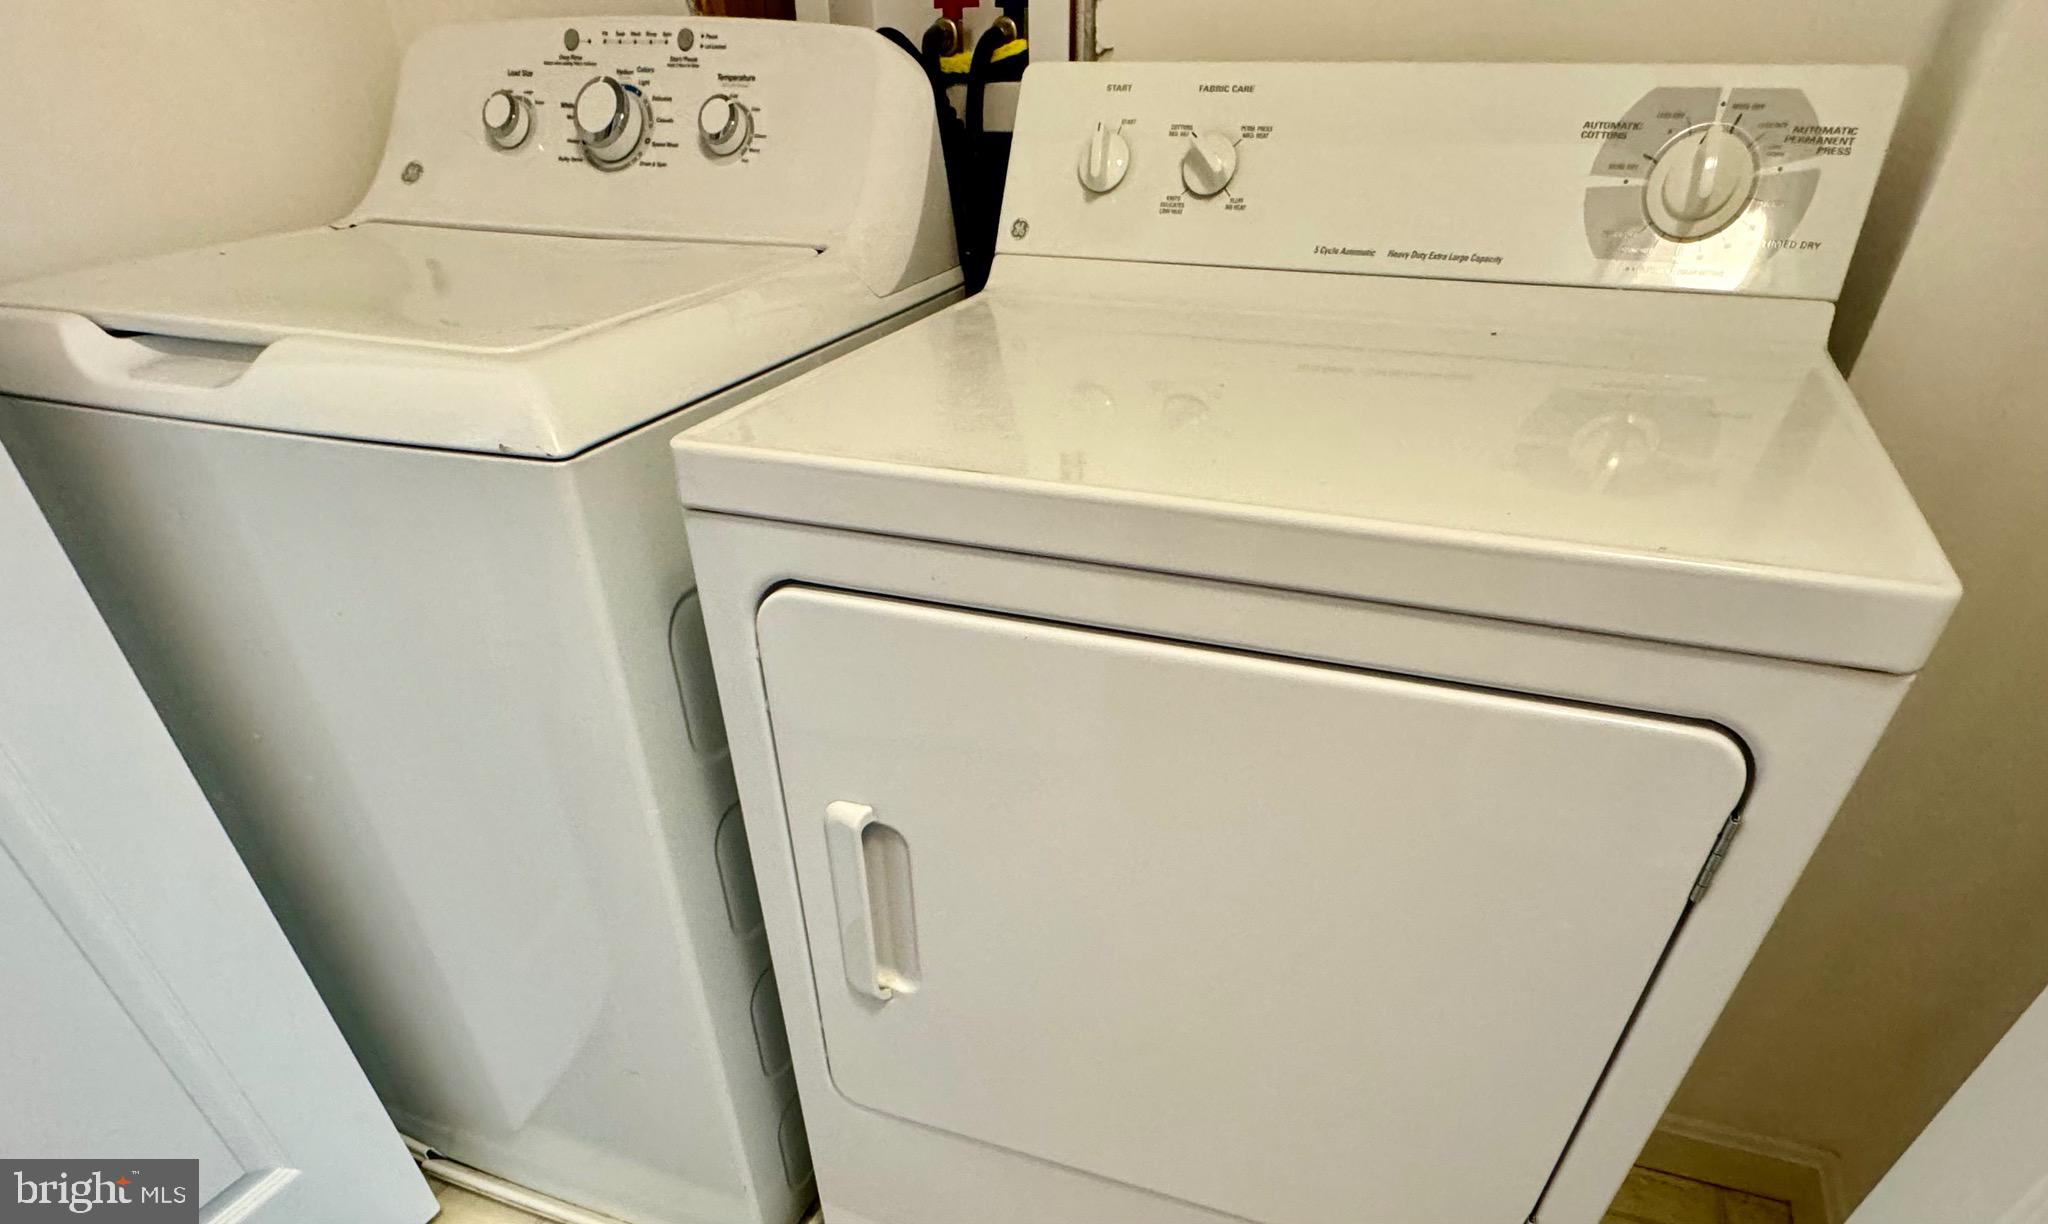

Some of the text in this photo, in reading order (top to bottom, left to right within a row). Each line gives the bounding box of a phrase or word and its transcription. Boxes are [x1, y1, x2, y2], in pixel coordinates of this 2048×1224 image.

[717, 73, 756, 82] Temperature
[1106, 84, 1133, 92] START
[1199, 85, 1256, 93] FABRIC CARE
[1582, 121, 1643, 130] AUTOMATIC
[1581, 130, 1628, 139] COTTONS
[1792, 126, 1859, 136] AUTOMATIC
[1784, 135, 1857, 146] PERMANENT
[1815, 146, 1852, 156] PRESS
[1799, 240, 1822, 250] DRY
[1320, 246, 1339, 256] Cycle
[1340, 247, 1376, 257] Automatic
[1387, 249, 1410, 260] Heavy
[1410, 250, 1427, 261] Duty
[1428, 251, 1447, 261] Extra
[1448, 252, 1469, 263] Large
[1470, 253, 1504, 265] Capacity
